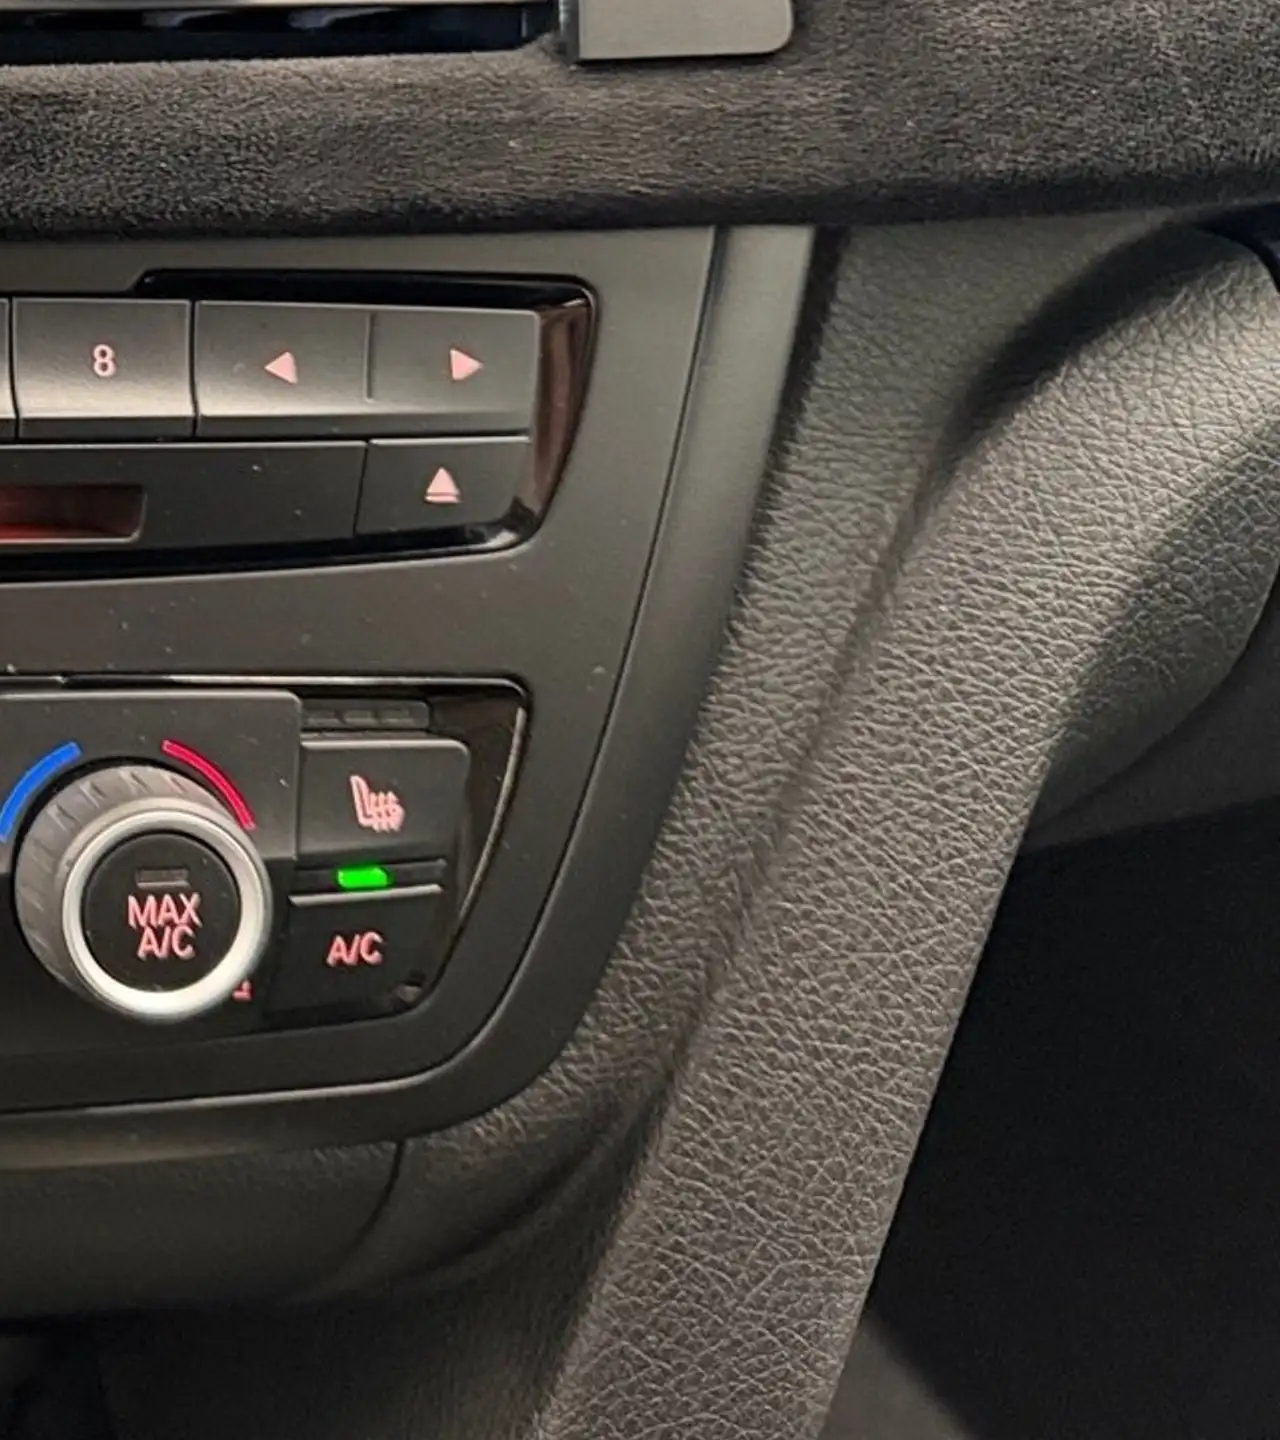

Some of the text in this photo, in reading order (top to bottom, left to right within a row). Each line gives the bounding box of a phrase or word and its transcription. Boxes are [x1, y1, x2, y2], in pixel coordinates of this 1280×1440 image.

[93, 345, 115, 378] 8
[128, 893, 201, 927] MAX
[138, 925, 195, 960] A/C
[327, 931, 383, 967] A/C
